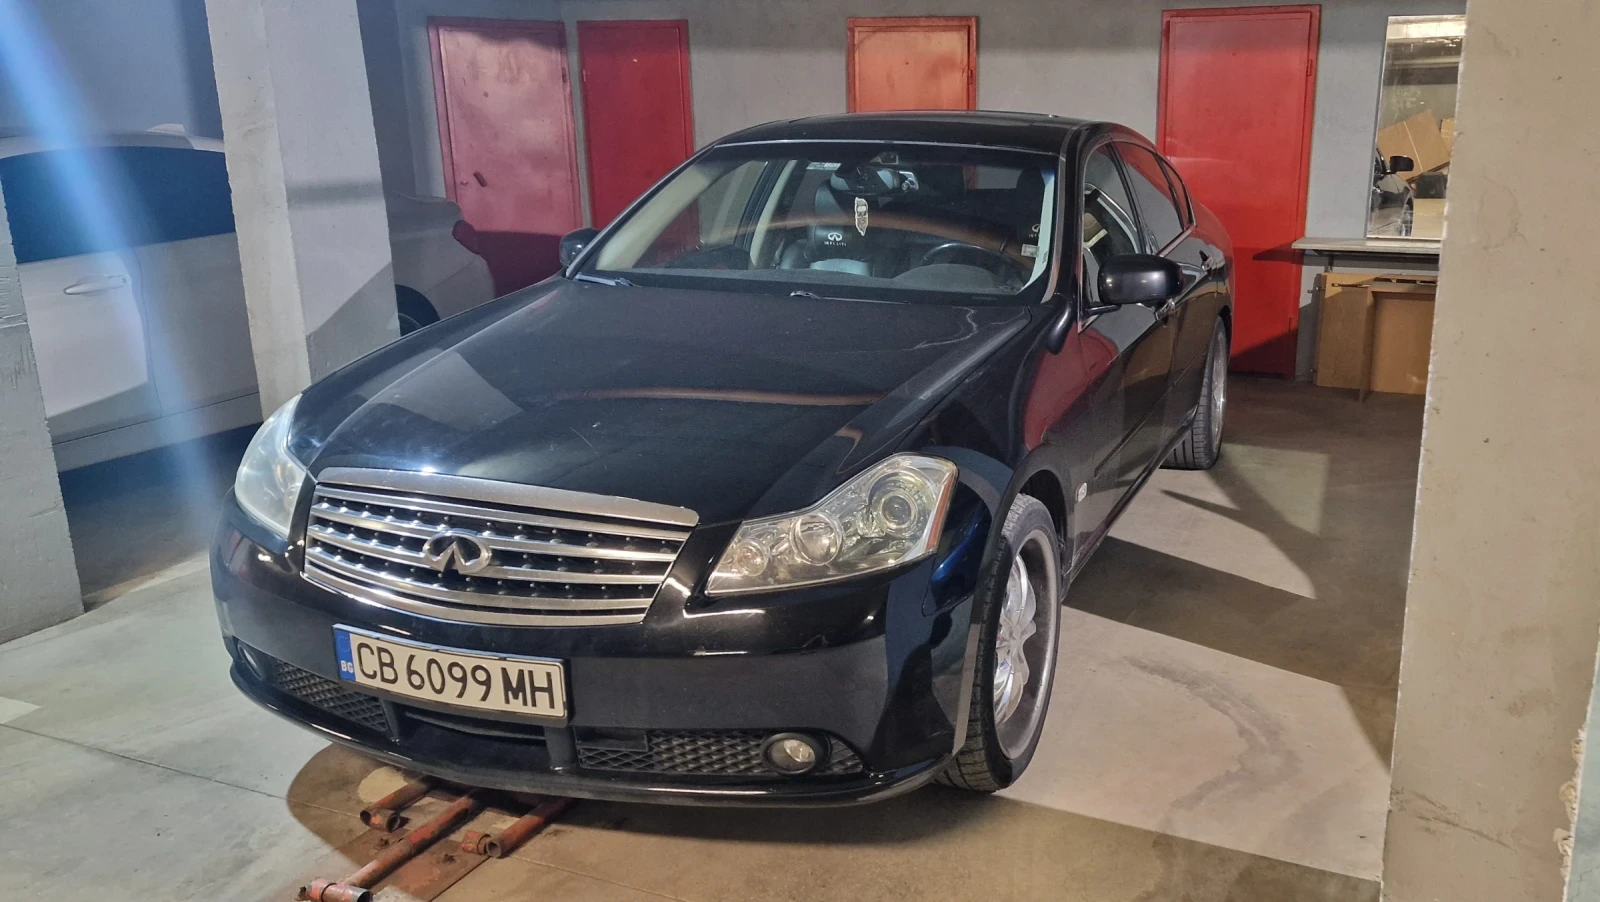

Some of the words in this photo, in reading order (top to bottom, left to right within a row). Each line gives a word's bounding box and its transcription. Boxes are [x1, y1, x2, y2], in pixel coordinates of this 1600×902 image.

[340, 660, 354, 673] BG
[356, 642, 399, 685] CB
[405, 654, 492, 702] 6099
[501, 667, 556, 709] MH
